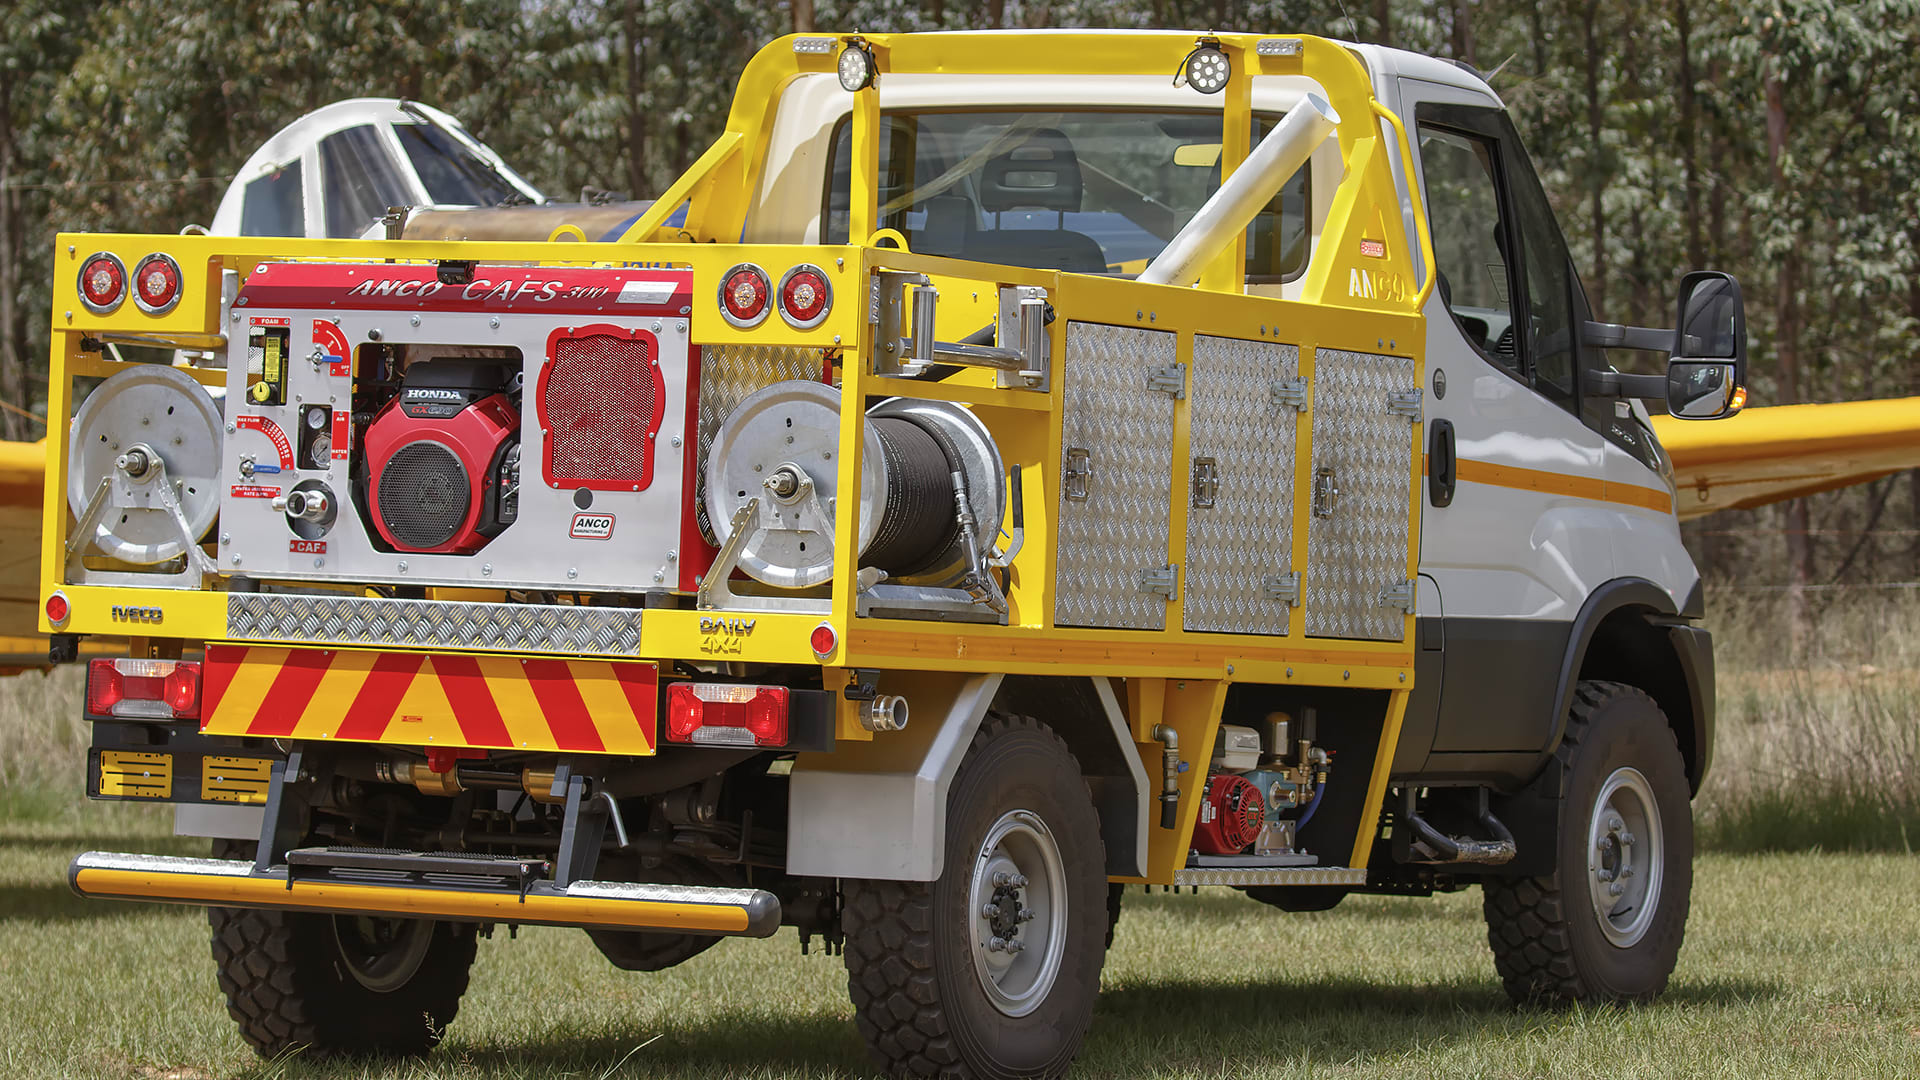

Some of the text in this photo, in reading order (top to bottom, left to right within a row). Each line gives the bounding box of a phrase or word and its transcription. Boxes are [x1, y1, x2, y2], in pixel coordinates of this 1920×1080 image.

[348, 279, 444, 297] ANCO
[461, 279, 563, 302] CAFS
[1349, 268, 1404, 302] ANCO
[407, 389, 462, 400] HONDA
[576, 518, 610, 528] ANCO
[297, 542, 321, 553] CAF
[112, 605, 163, 625] IVECO
[700, 616, 756, 636] DAILY
